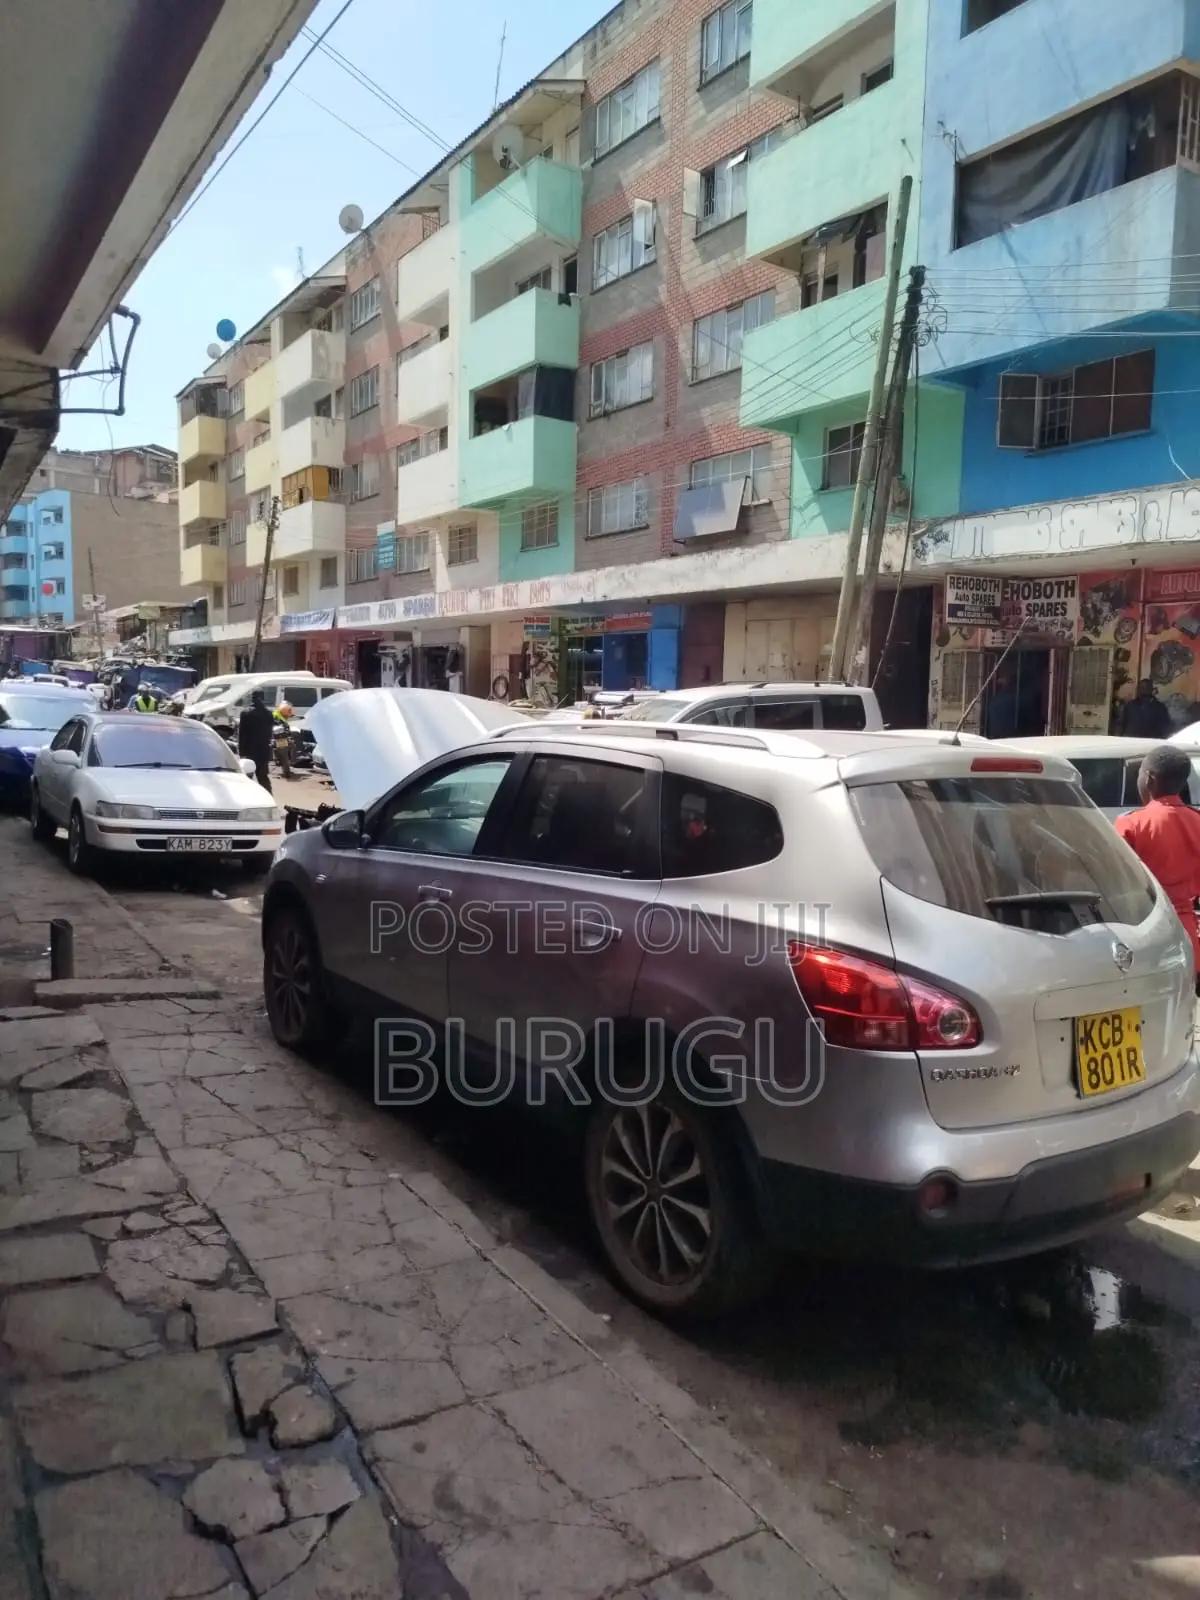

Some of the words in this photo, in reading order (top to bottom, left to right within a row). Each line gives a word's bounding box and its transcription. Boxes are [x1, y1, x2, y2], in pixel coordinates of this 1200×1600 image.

[949, 576, 1000, 593] REHOBOTH
[1002, 580, 1076, 600] EHOBOTH
[971, 593, 996, 606] SPARES
[1025, 601, 1068, 618] SPARES
[168, 839, 193, 850] KAM
[199, 839, 232, 850] 823Y
[1083, 1014, 1124, 1055] KCB
[1086, 1046, 1142, 1091] 801R
